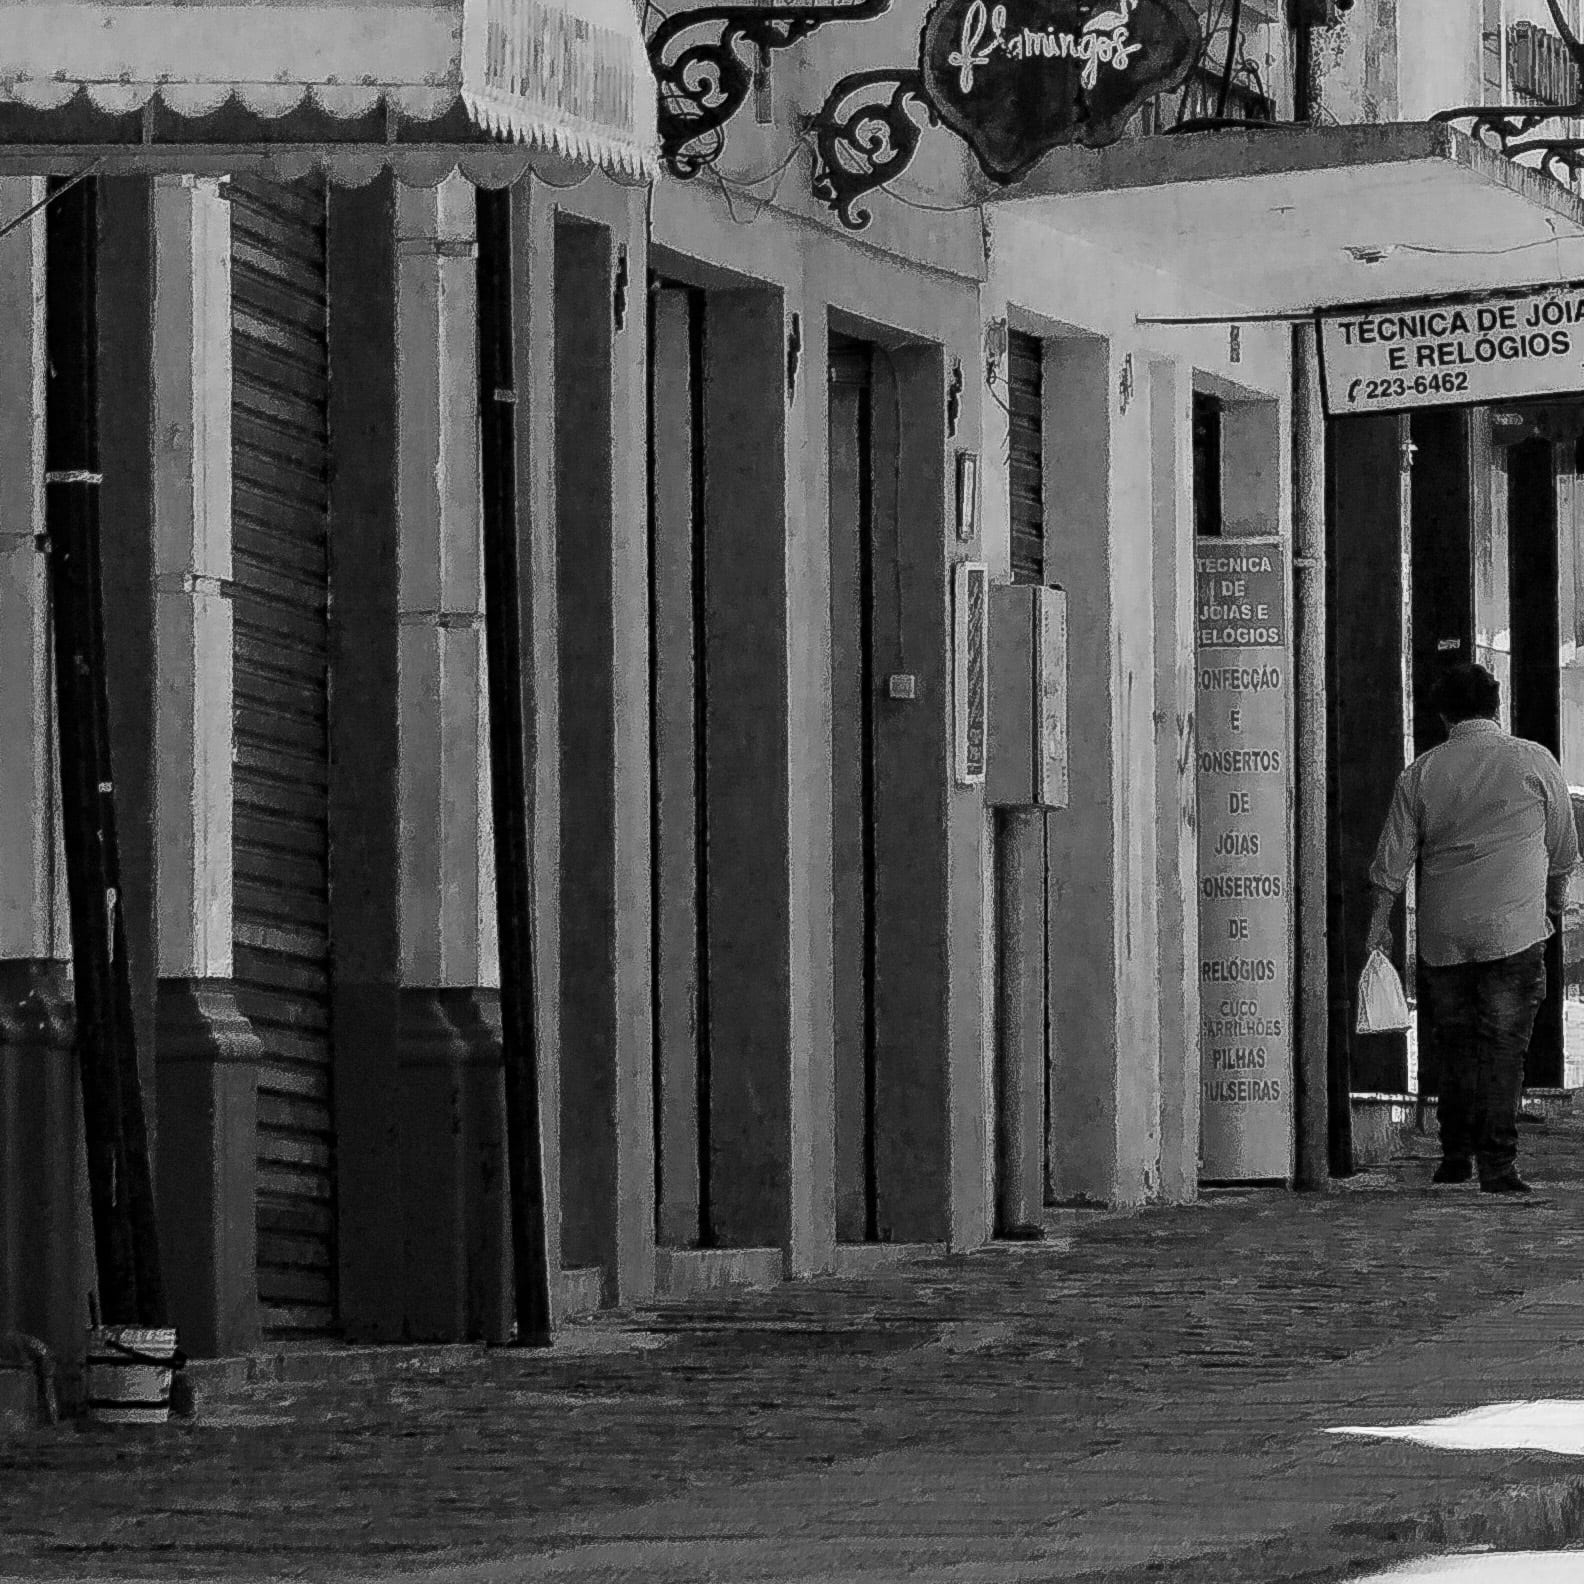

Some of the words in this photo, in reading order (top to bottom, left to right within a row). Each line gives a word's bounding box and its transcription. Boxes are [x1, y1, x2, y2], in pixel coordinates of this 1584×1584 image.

[1338, 310, 1470, 345] TÉCNICA
[1477, 305, 1518, 333] DE
[1389, 347, 1408, 371] E
[1416, 330, 1571, 369] RELÓGIOS
[1365, 372, 1470, 400] 223-6462
[1221, 579, 1246, 598] DE
[1257, 604, 1269, 620] E
[1202, 623, 1279, 644] ELÓGIOS
[1200, 665, 1281, 693] ONFECÇÃO
[1230, 709, 1240, 731] E
[1200, 751, 1281, 773] ONSERTOS
[1229, 792, 1250, 815] DE
[1215, 829, 1260, 856] JÓIAS
[1203, 876, 1281, 898] ONSERTOS
[1229, 918, 1249, 939] DE
[1202, 956, 1276, 982] RELÓGIOS
[1220, 1000, 1258, 1017] CUCO
[1203, 1019, 1282, 1037] ARRILHÕES
[1212, 1048, 1266, 1070] PILHAS
